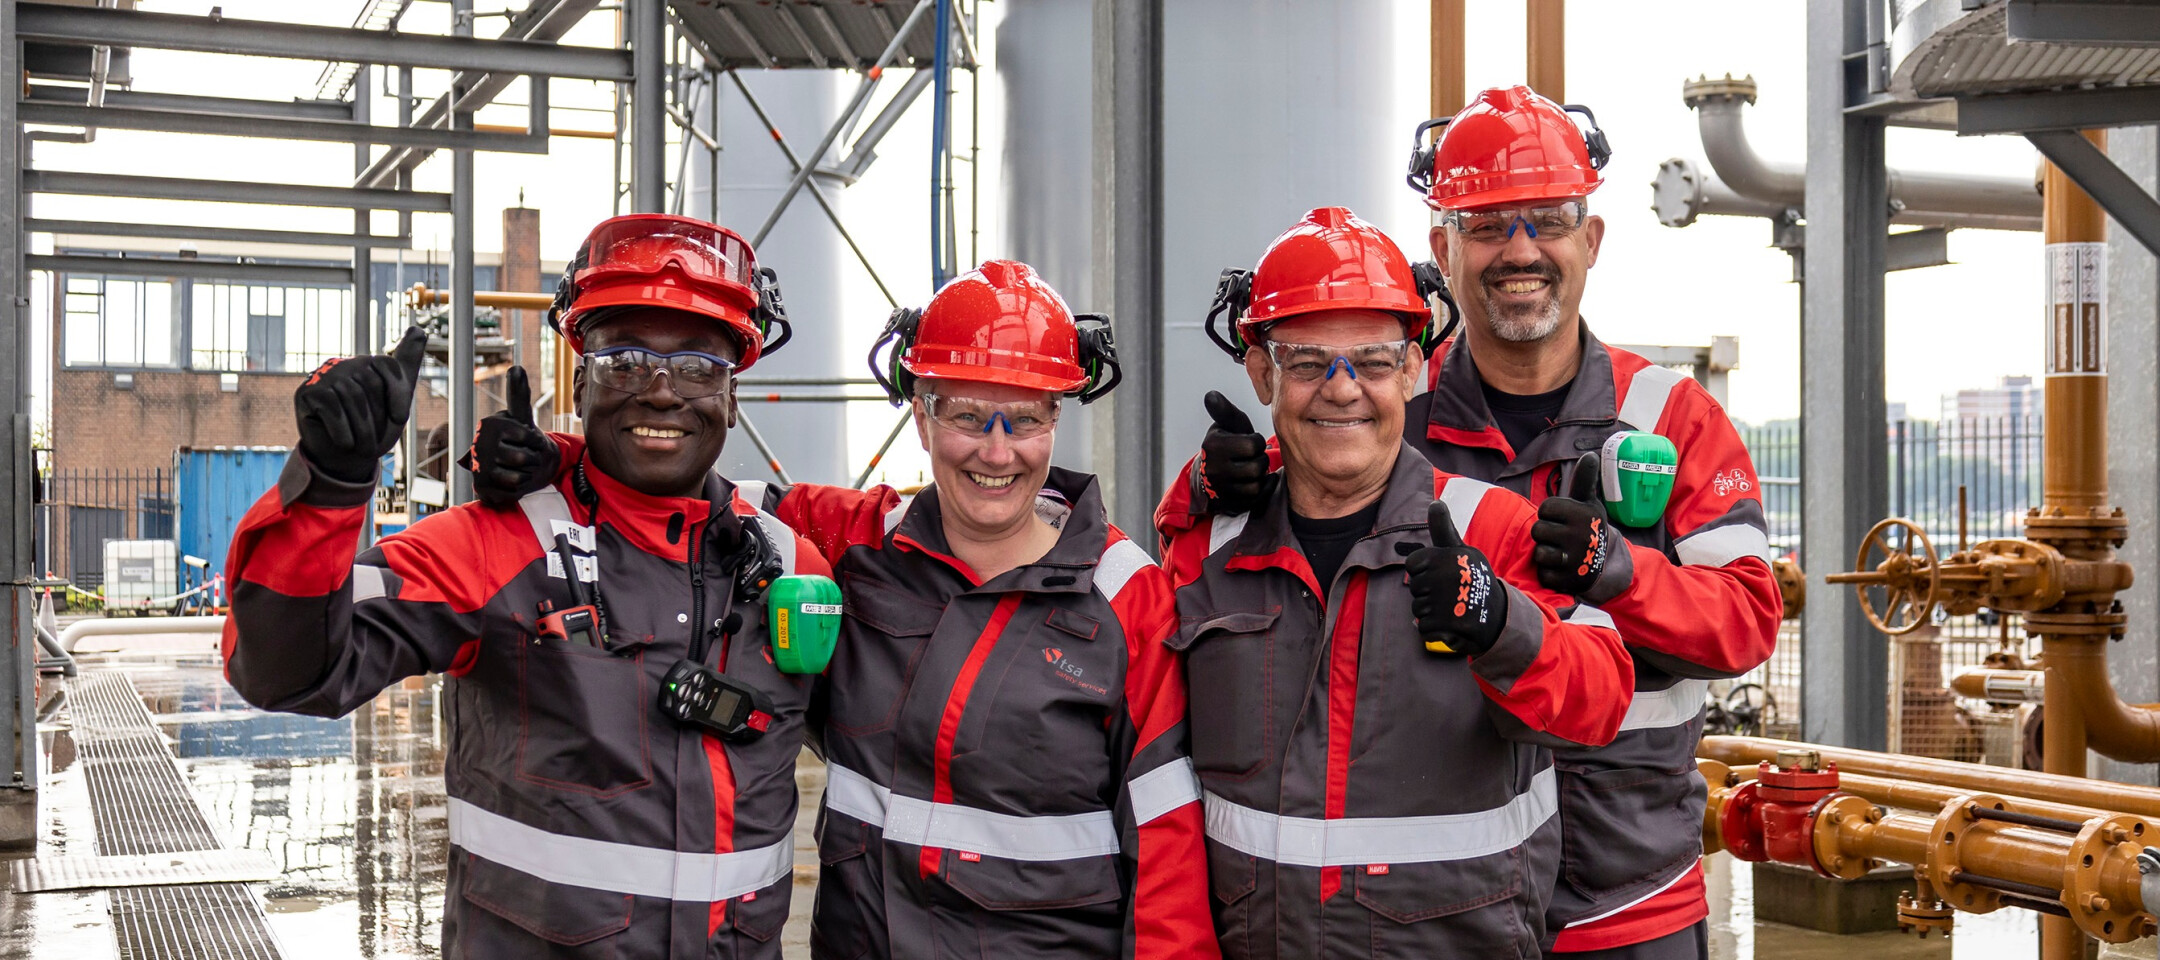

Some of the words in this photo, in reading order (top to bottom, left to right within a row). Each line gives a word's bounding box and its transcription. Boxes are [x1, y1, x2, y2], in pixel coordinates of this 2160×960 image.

[1578, 517, 1601, 576] OXXA
[1454, 554, 1472, 617] OXXA
[1055, 670, 1077, 684] safety
[1077, 681, 1108, 696] services
[1060, 658, 1084, 677] tsa
